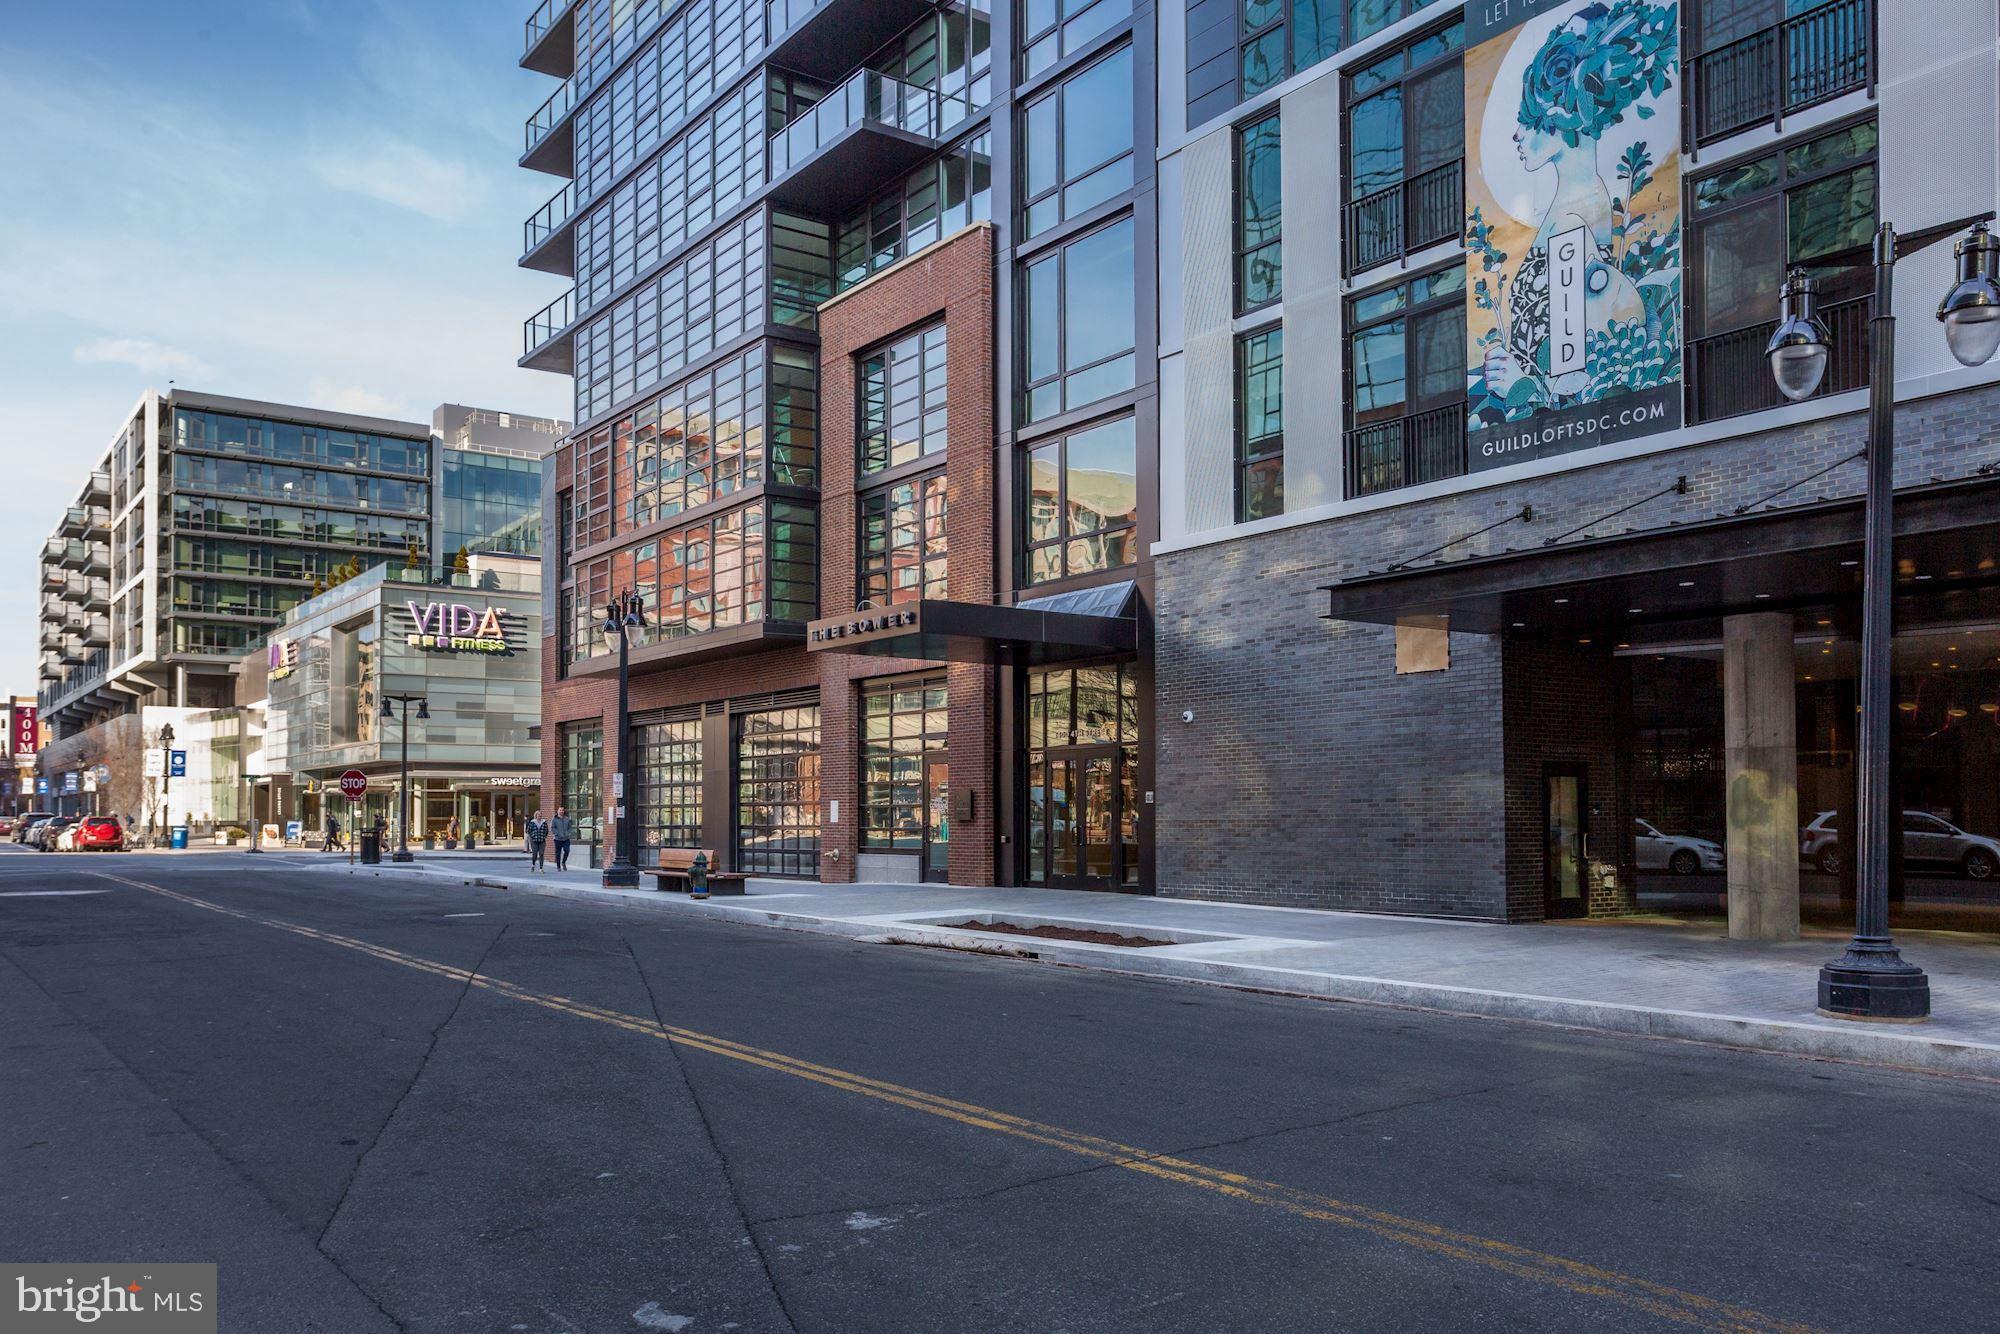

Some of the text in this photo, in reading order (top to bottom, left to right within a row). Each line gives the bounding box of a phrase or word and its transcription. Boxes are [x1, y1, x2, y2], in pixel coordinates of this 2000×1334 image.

[1485, 0, 1509, 26] LET
[1558, 242, 1576, 363] GUILD
[1482, 401, 1665, 457] GUILDLOFTSDC.COM
[407, 600, 503, 639] VIDA
[811, 610, 916, 641] THE BOWER
[451, 636, 506, 650] FITNESS
[341, 778, 366, 789] STOP
